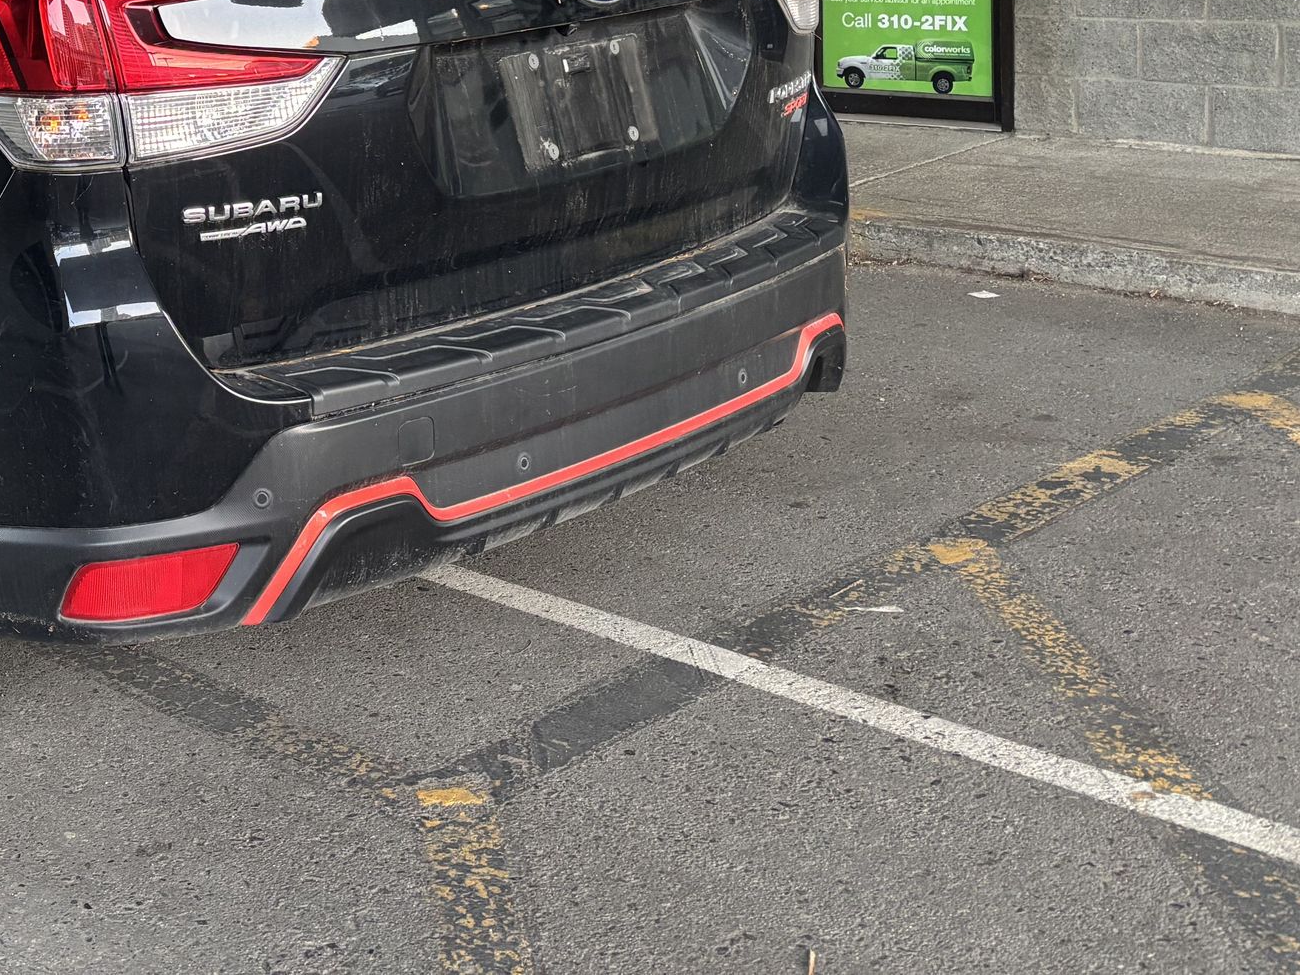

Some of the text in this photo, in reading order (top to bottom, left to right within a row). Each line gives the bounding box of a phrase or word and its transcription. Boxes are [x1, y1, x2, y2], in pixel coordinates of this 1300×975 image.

[842, 11, 968, 32] Call 310-2FIX
[924, 43, 971, 54] colorworks
[182, 191, 323, 224] SUBARU
[241, 216, 307, 236] AWD
